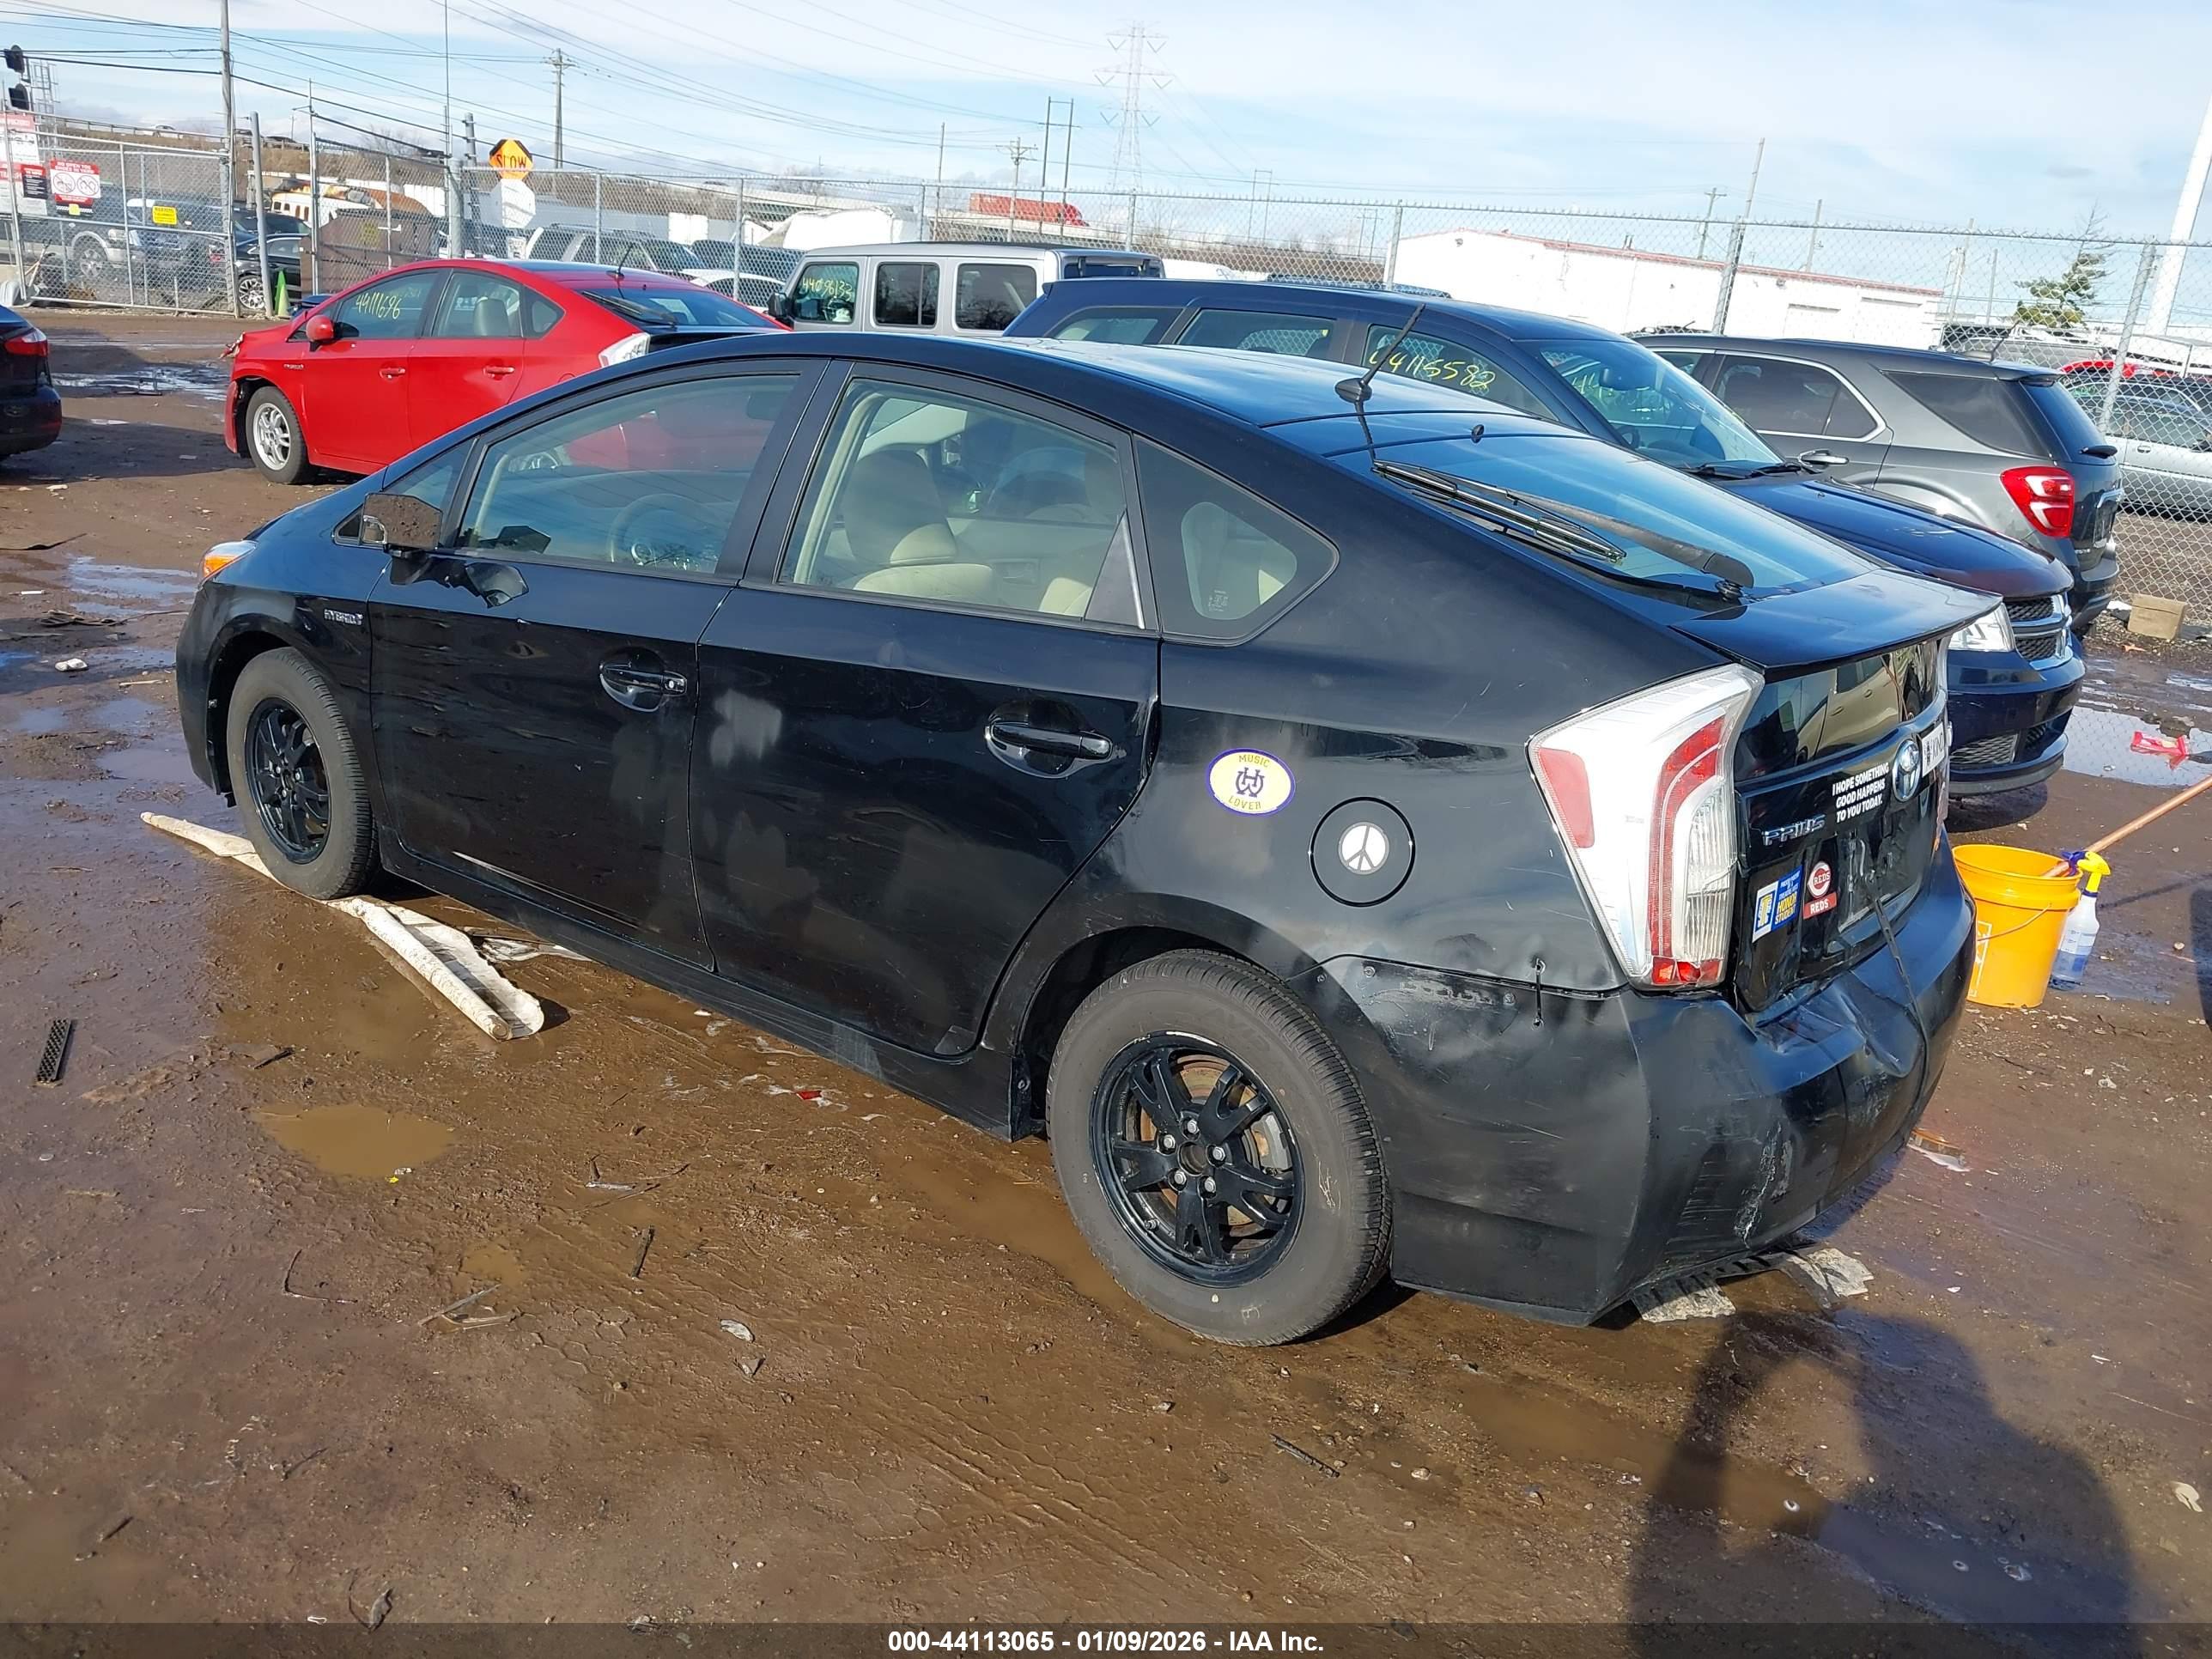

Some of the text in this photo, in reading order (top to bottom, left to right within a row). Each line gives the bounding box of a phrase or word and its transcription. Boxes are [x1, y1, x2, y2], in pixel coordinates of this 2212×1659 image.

[496, 154, 527, 169] SLOW
[1238, 754, 1270, 768] MUSIC
[1832, 762, 1889, 797] I HOPE SOMETHING
[1228, 795, 1261, 811] LOVER
[1836, 778, 1886, 809] GOOD HAPPENS
[1836, 793, 1883, 823] TO YOU TODAY.
[1762, 814, 1826, 847] PRIUS
[1813, 871, 1831, 885] REDS
[1776, 890, 1798, 915] HONOR
[1810, 898, 1829, 915] REDS
[1774, 903, 1796, 925] STUDENT
